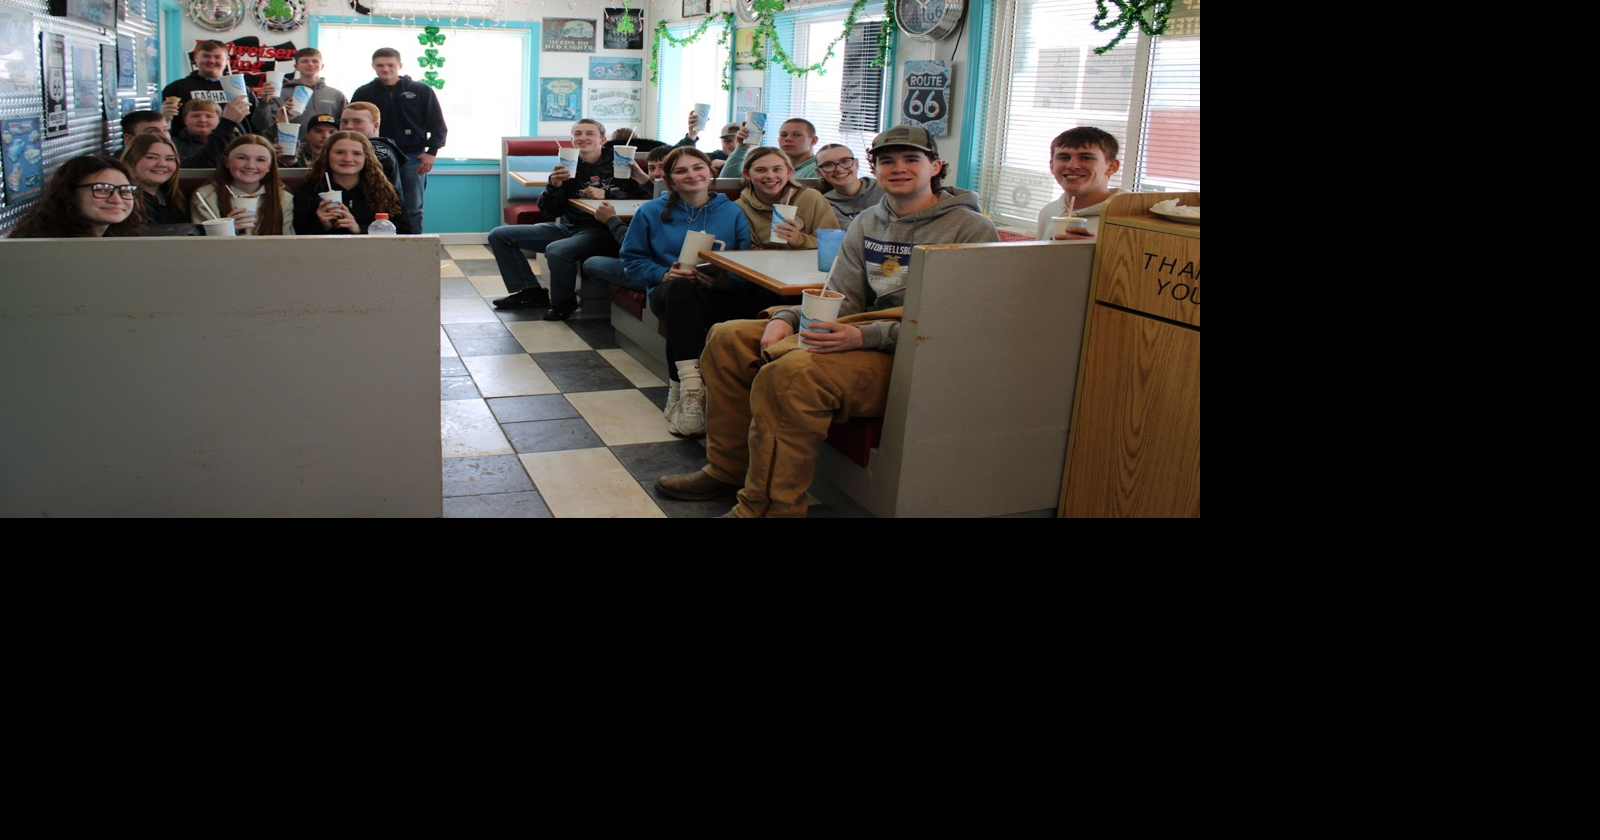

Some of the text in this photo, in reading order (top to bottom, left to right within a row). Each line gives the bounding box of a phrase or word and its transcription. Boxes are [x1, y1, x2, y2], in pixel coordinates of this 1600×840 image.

[910, 75, 943, 87] ROUTE
[194, 91, 227, 102] CARHA
[908, 90, 941, 119] 66
